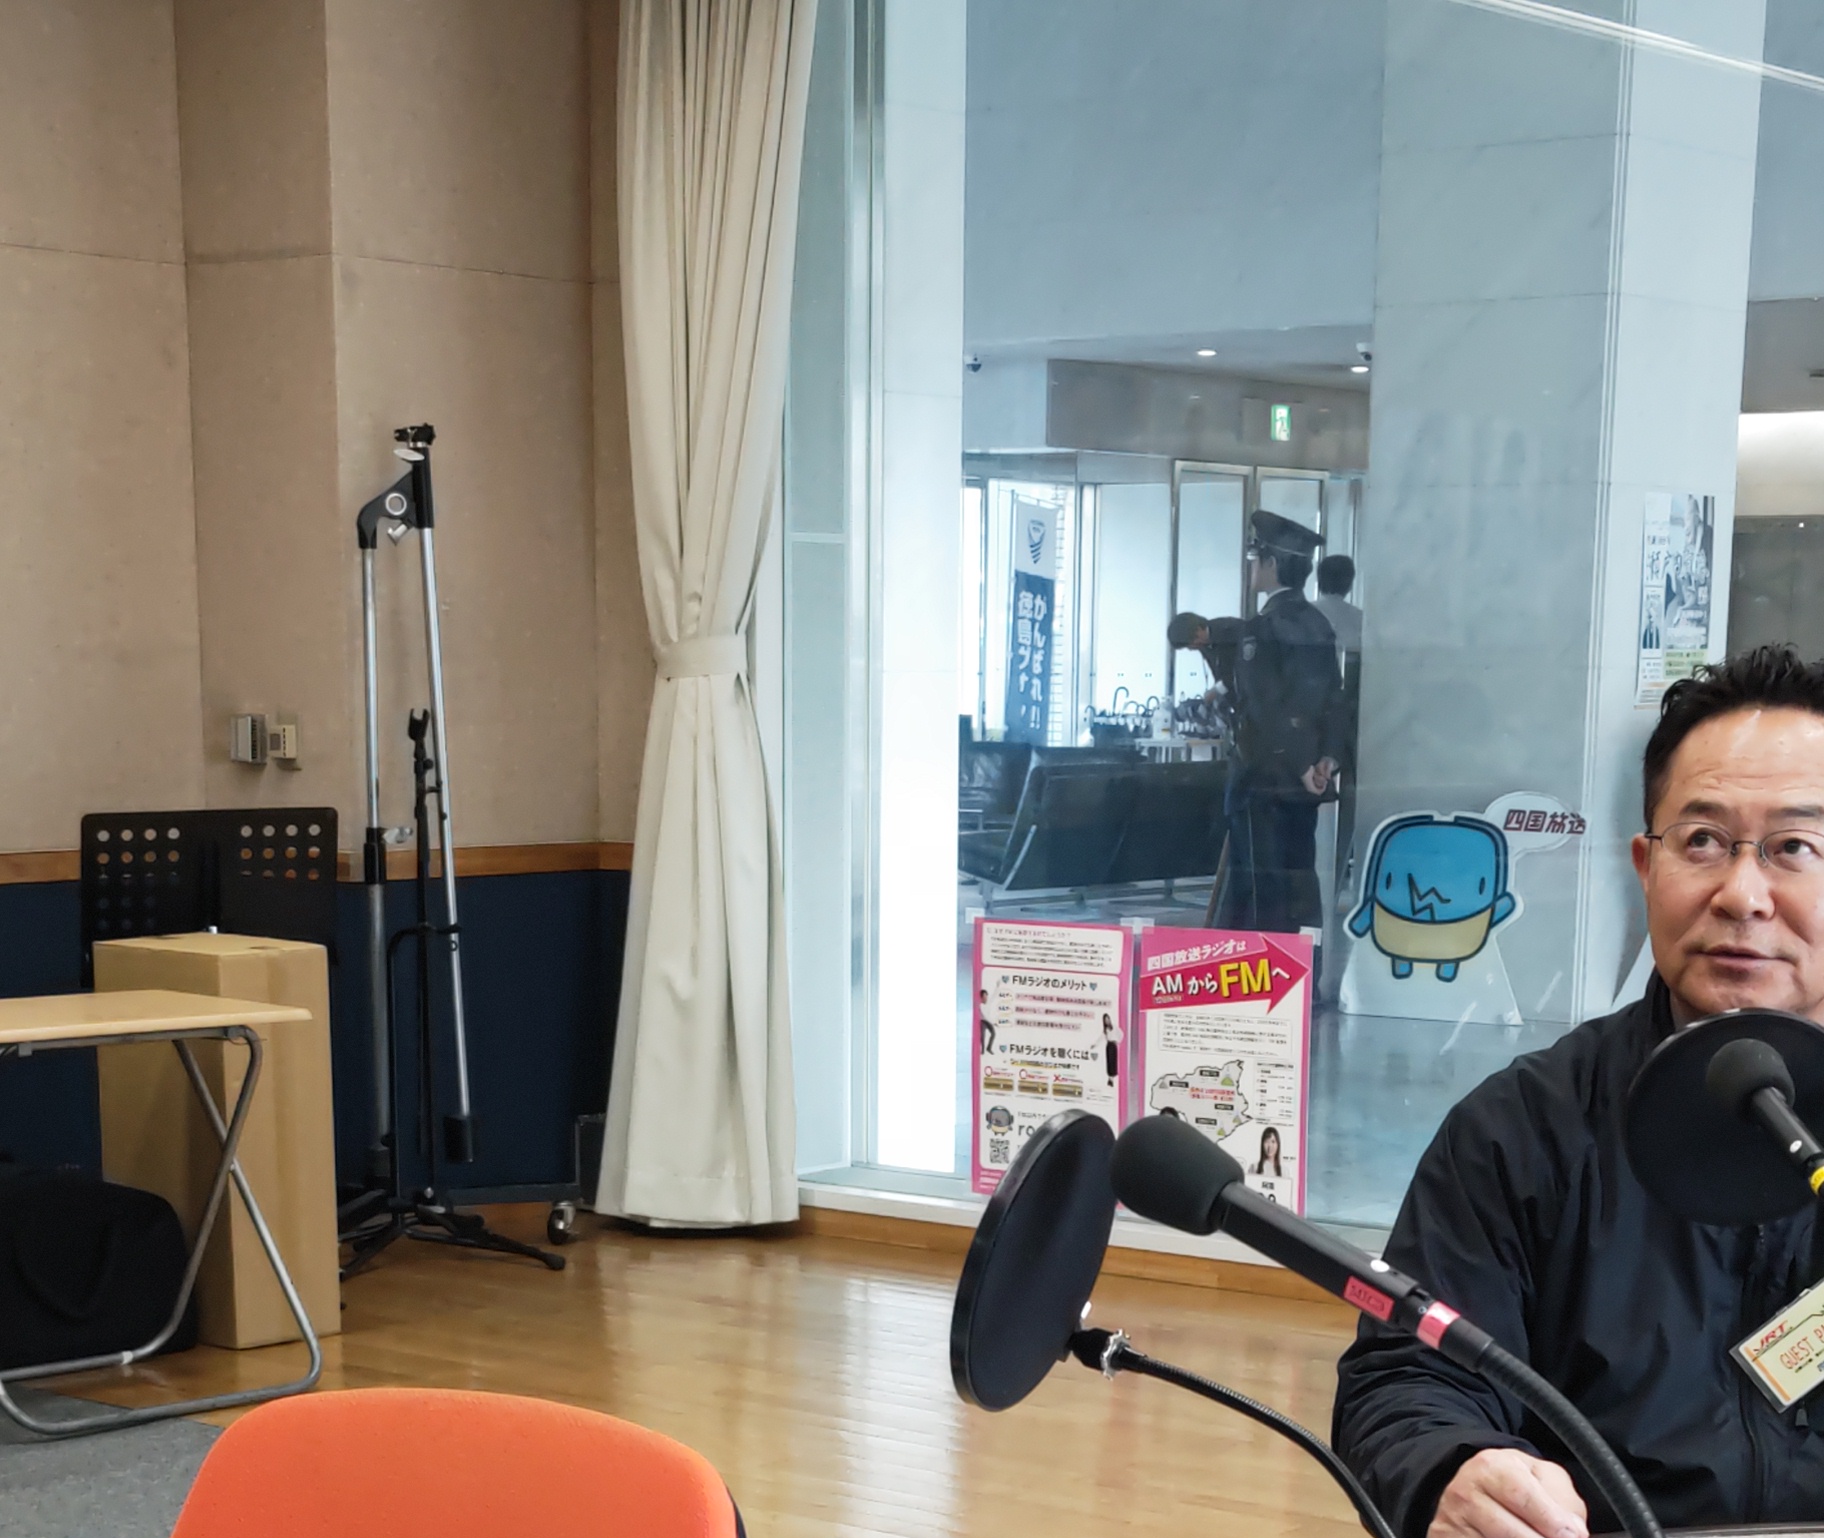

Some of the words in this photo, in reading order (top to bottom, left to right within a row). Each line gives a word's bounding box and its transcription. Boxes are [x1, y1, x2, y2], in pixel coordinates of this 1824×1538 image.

[1503, 809, 1586, 835] 四国放送
[1779, 1335, 1815, 1370] GUEST
